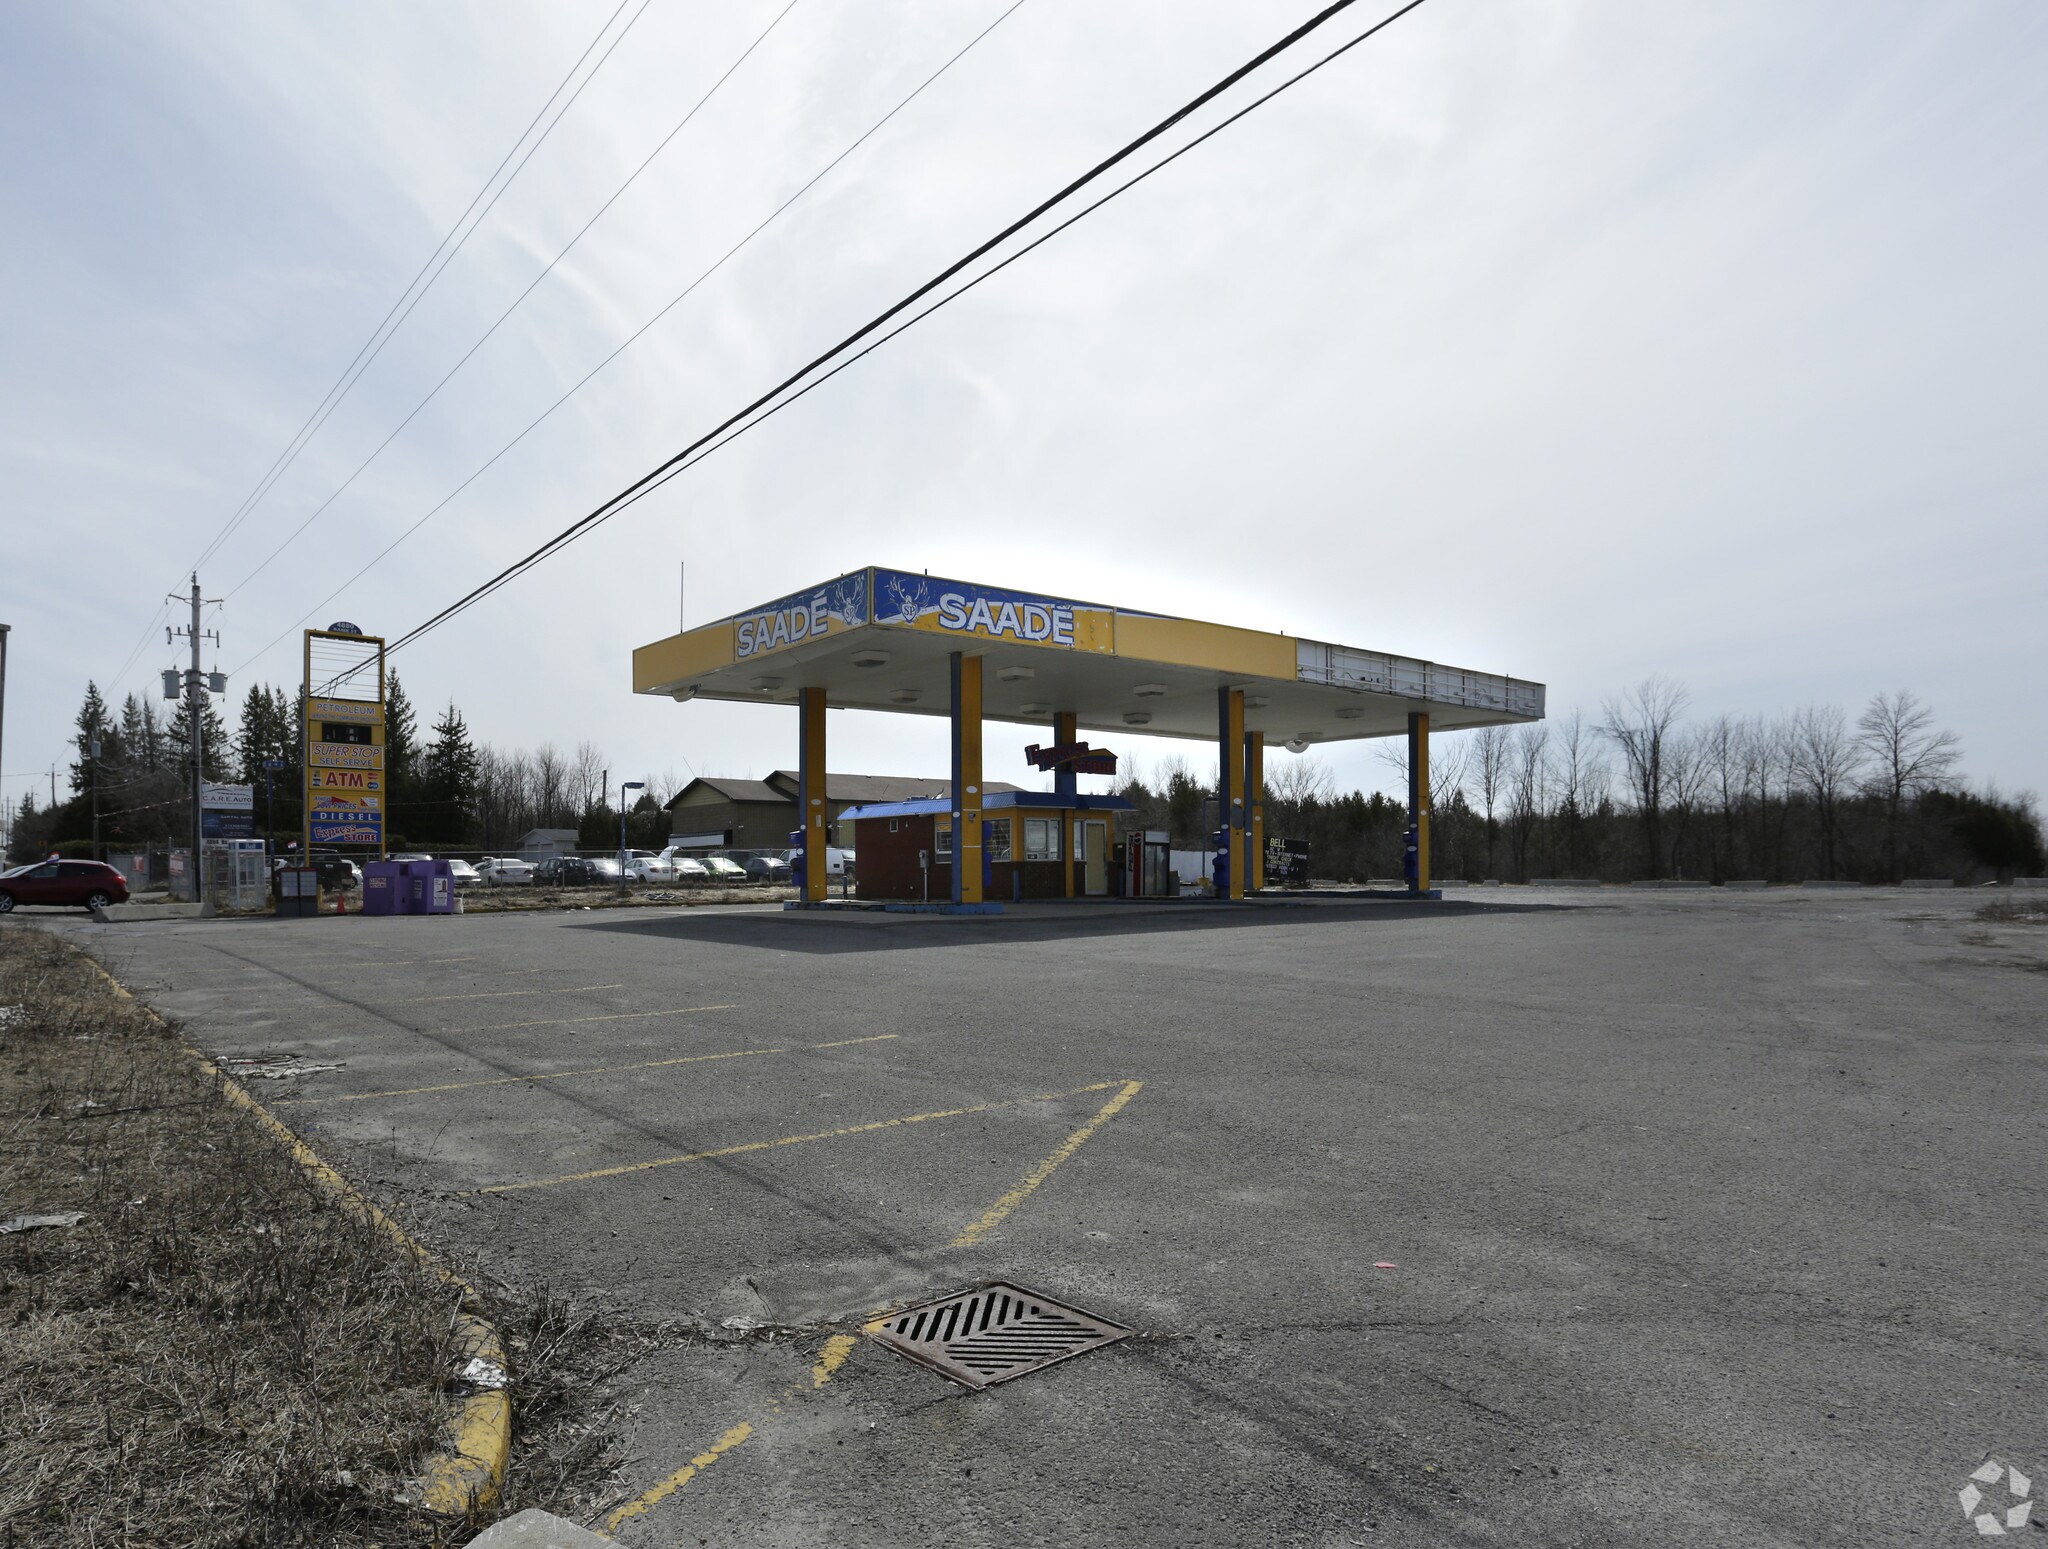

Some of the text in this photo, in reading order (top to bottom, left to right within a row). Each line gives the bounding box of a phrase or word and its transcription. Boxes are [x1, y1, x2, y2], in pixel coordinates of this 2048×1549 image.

[845, 607, 854, 618] SP
[904, 605, 915, 616] SP
[736, 588, 829, 658] SAADÉ
[938, 592, 1075, 645] SAADÉ
[316, 703, 376, 715] PETROLEUM
[314, 745, 380, 758] SUPER STOP
[319, 757, 373, 767] SELF SERVE
[325, 771, 364, 788] ATM
[316, 801, 332, 809] LOW
[333, 802, 357, 810] PRICES
[320, 812, 373, 821] DIESEL
[314, 824, 357, 839] Express
[344, 833, 377, 842] STORE
[1269, 837, 1286, 848] BELL
